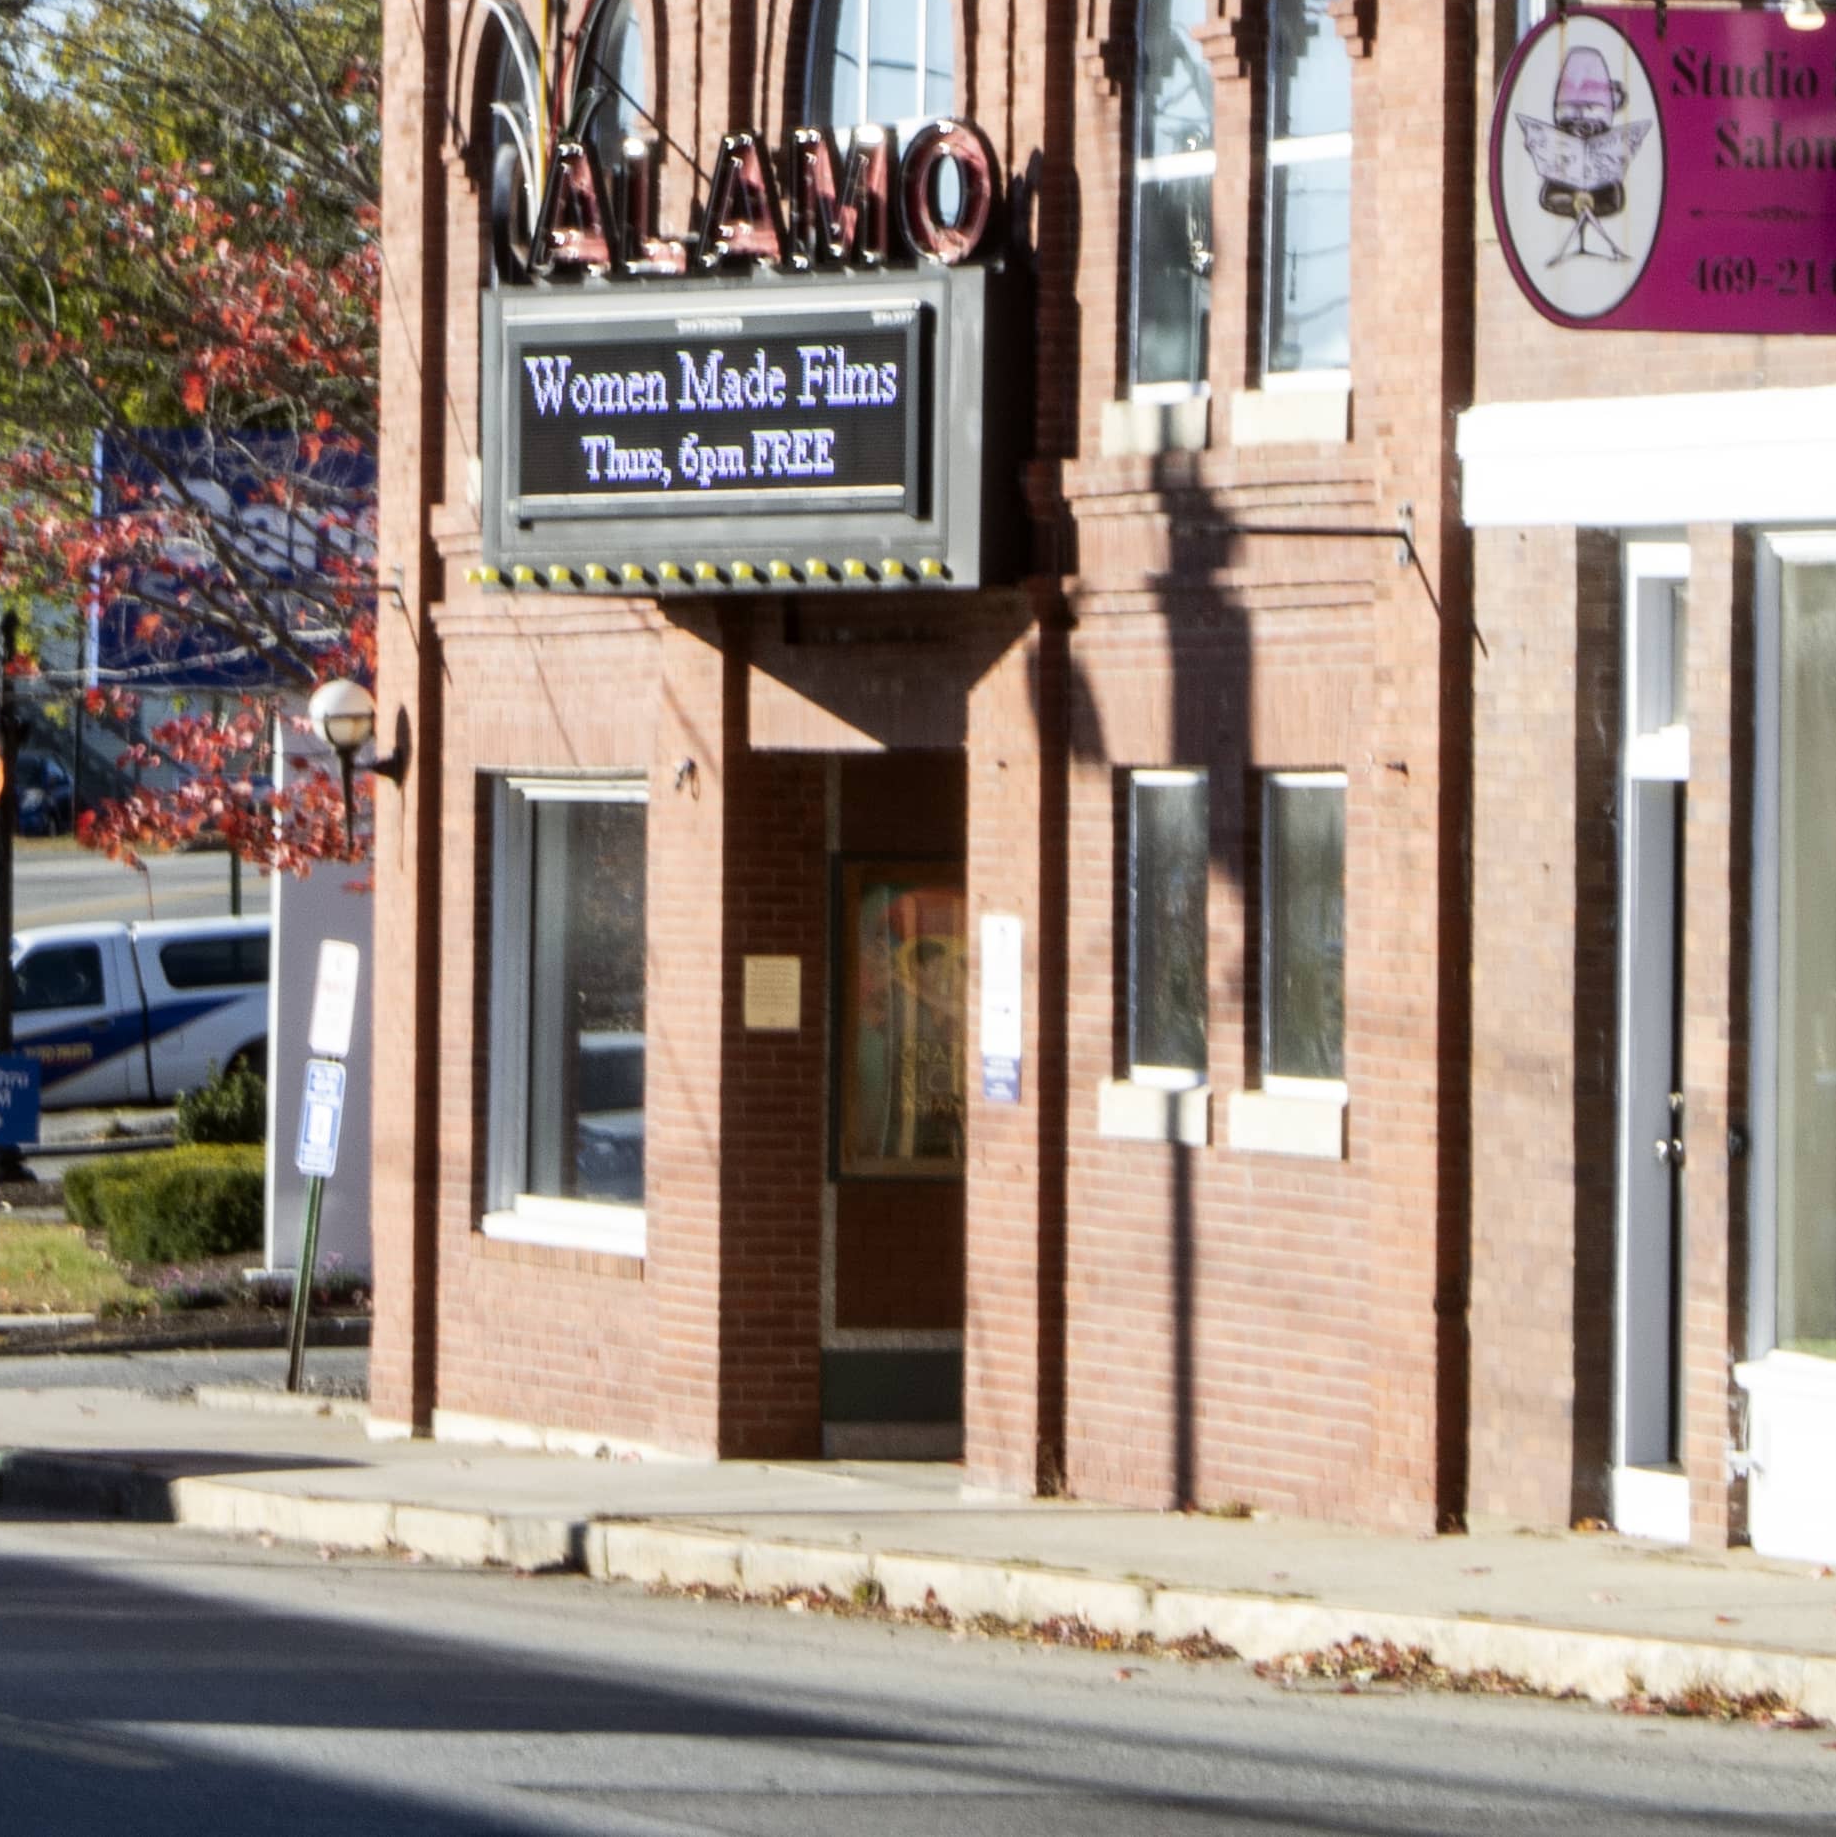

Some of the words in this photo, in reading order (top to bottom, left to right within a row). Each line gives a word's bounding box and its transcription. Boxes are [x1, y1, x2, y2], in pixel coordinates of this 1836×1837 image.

[1671, 44, 1820, 100] Studio
[527, 116, 1002, 275] ALAMO
[524, 354, 668, 416] Women
[676, 350, 787, 412] Made
[796, 345, 898, 408] Films
[581, 434, 672, 488] Thurs,
[678, 431, 747, 488] 6pm
[751, 427, 835, 476] FREE
